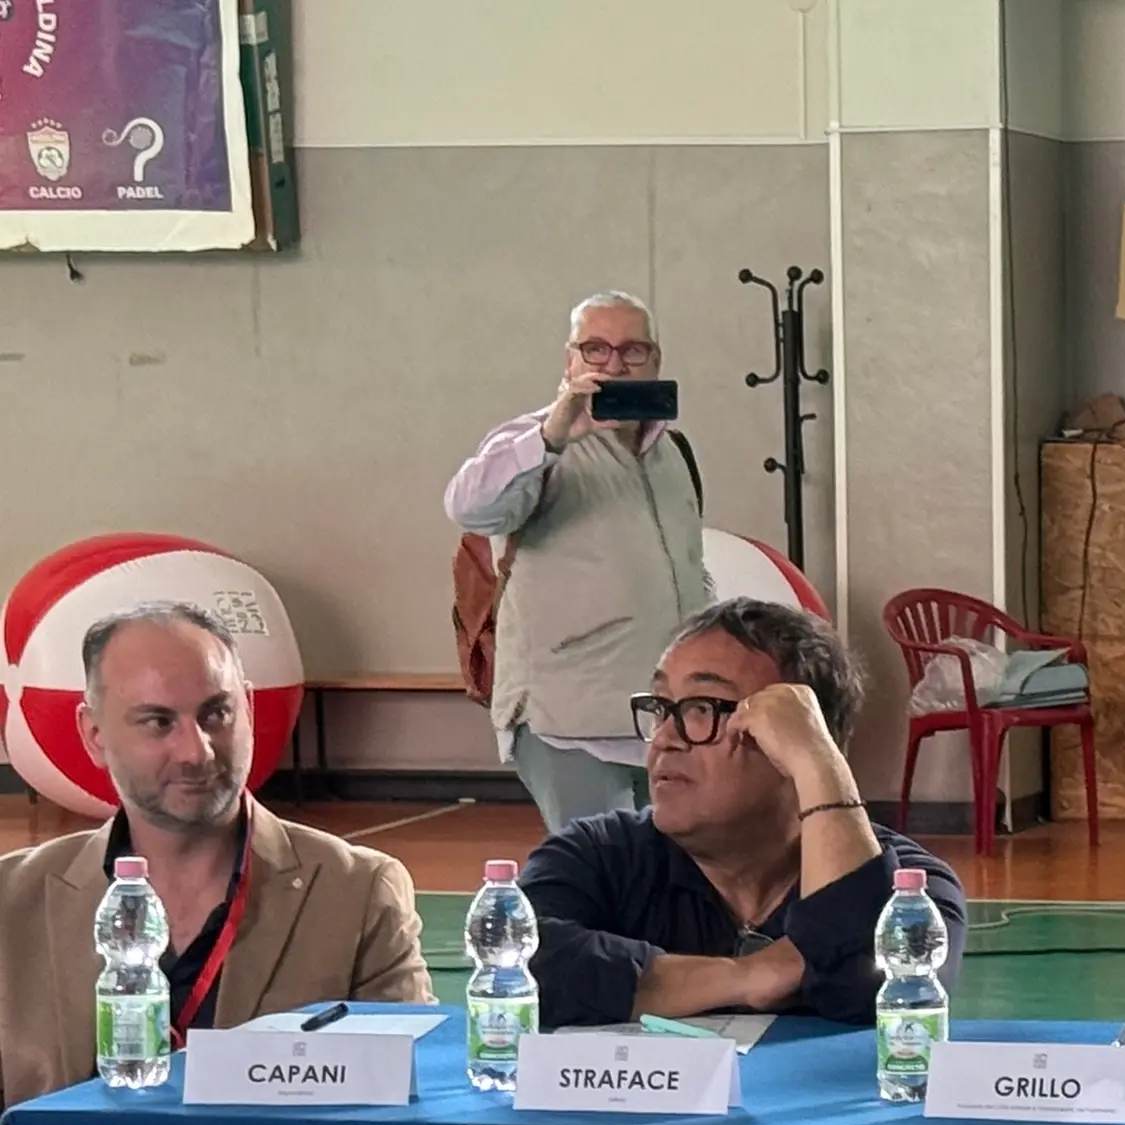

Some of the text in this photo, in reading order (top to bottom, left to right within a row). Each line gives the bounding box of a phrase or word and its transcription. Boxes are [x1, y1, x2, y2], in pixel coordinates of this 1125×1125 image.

[28, 186, 83, 200] CALCIO
[116, 186, 165, 200] PADEL
[247, 1063, 347, 1084] CAPANI
[558, 1067, 681, 1091] STRAFACE
[994, 1075, 1083, 1099] GRILLO
